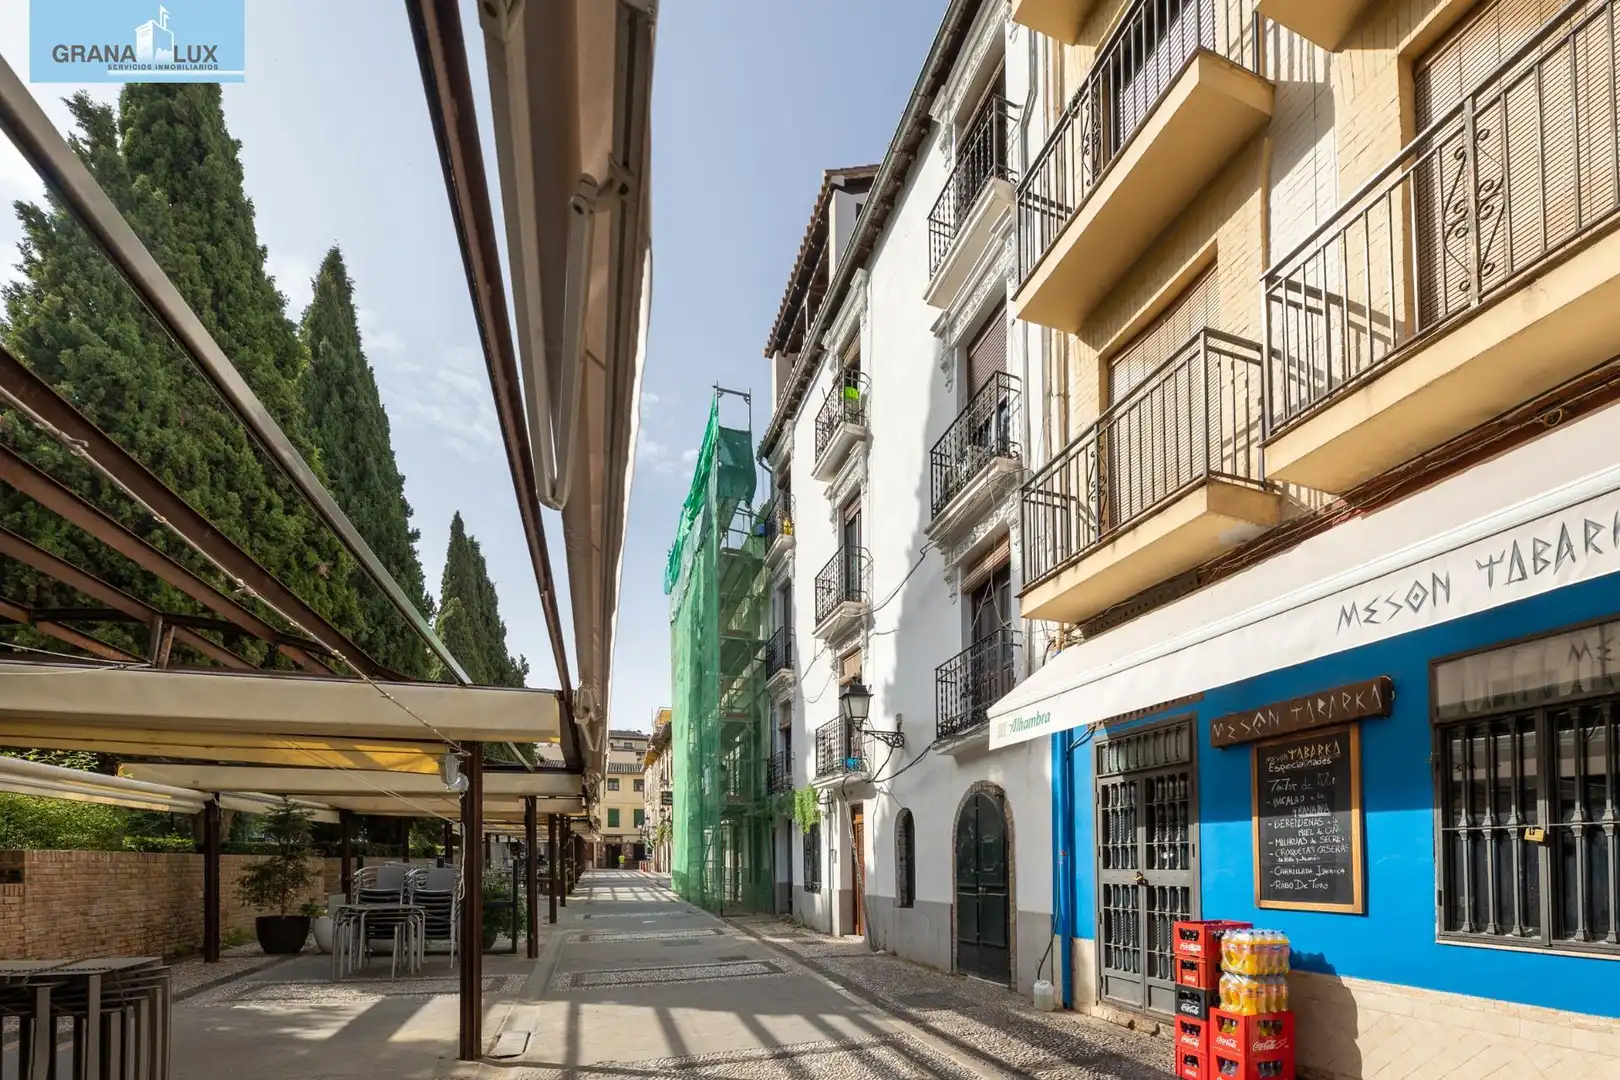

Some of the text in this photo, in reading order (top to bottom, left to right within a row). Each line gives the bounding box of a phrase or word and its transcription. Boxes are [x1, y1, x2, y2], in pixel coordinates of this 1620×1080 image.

[1336, 571, 1450, 635] MESON
[1009, 711, 1051, 735] Alhambra
[1212, 683, 1382, 739] MESON TABARKA
[1288, 740, 1341, 761] TABARKA
[1253, 1039, 1276, 1052] Coca-Cola
